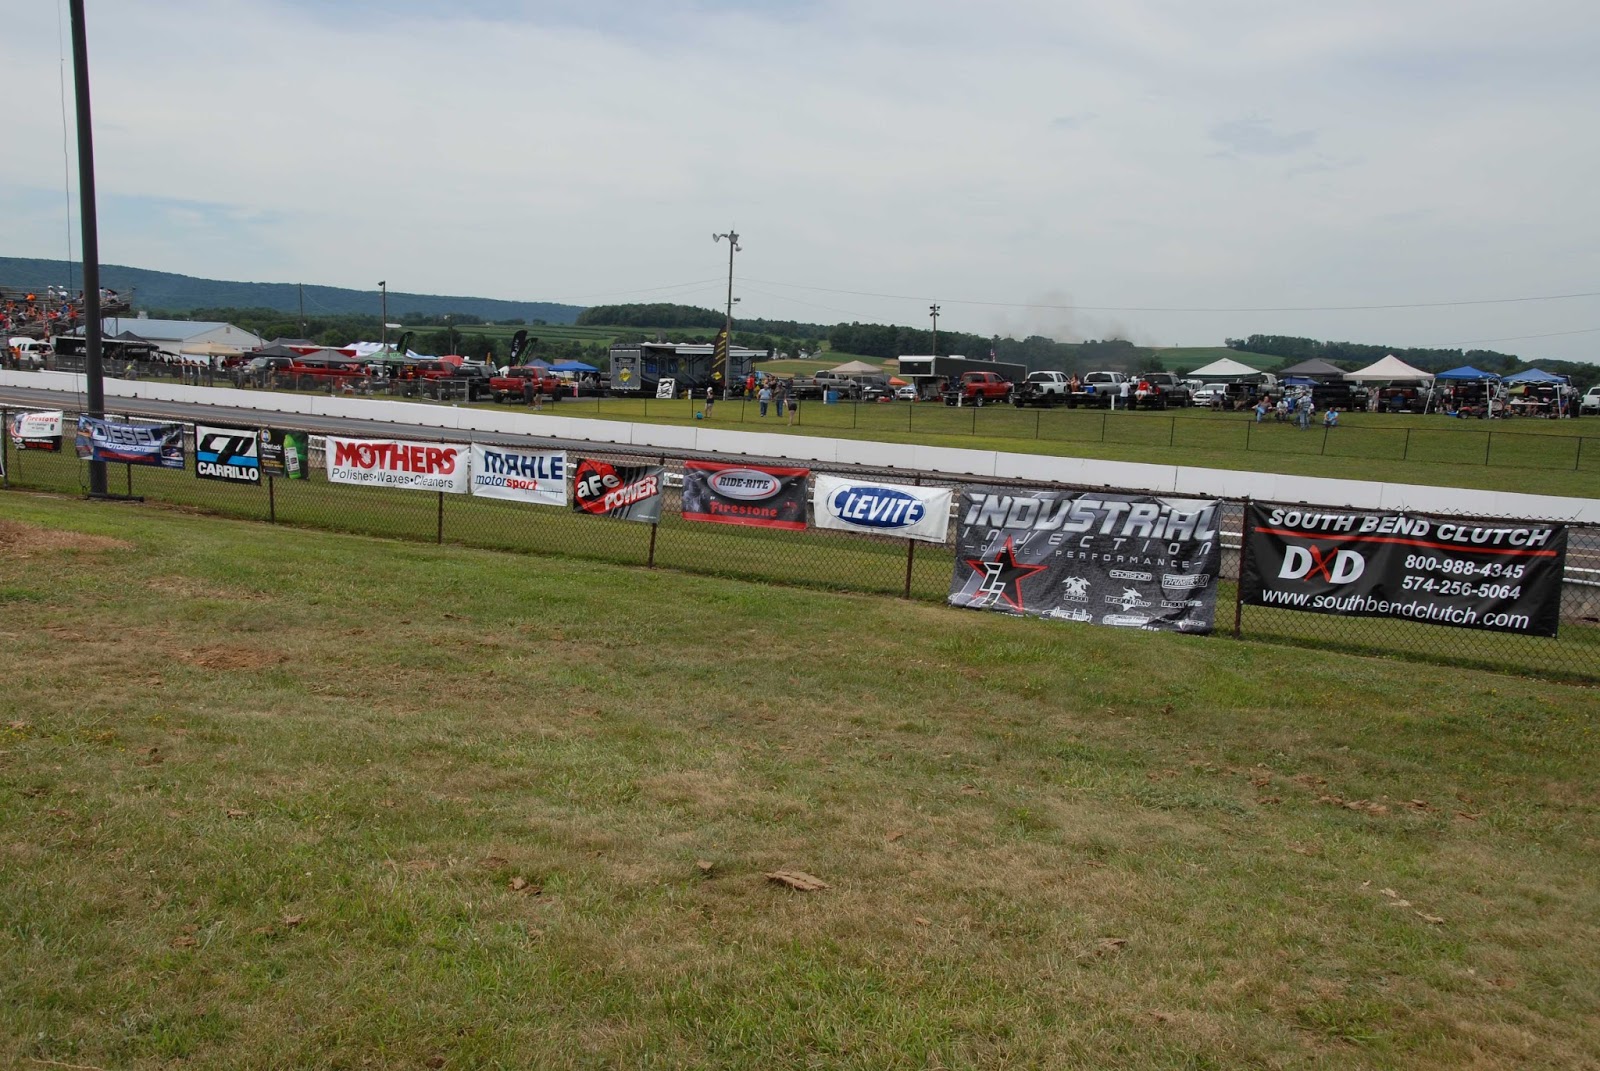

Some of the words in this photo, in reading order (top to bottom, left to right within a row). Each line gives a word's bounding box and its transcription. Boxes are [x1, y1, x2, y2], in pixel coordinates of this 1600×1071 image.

[92, 423, 160, 446] DIESEL
[335, 441, 457, 475] MOTHERS
[484, 450, 564, 480] MAHLE
[197, 461, 259, 481] CARRILLO
[475, 474, 538, 490] motorsport
[718, 476, 770, 490] RIDE-RITE
[604, 476, 657, 511] POWER
[828, 484, 923, 525] CLEVITE
[709, 501, 778, 517] Firestone
[1268, 509, 1355, 531] SOUTH
[1359, 516, 1430, 537] BEND
[1436, 523, 1552, 547] CLUTCH
[980, 544, 1042, 556] DIESEL
[1055, 550, 1190, 568] PERFORMANCE
[1278, 544, 1365, 584] DXD
[1404, 554, 1526, 579] 800-988-4345
[1401, 575, 1521, 600] 574-256-5064
[1262, 589, 1530, 629] www.southbendclutch.com
